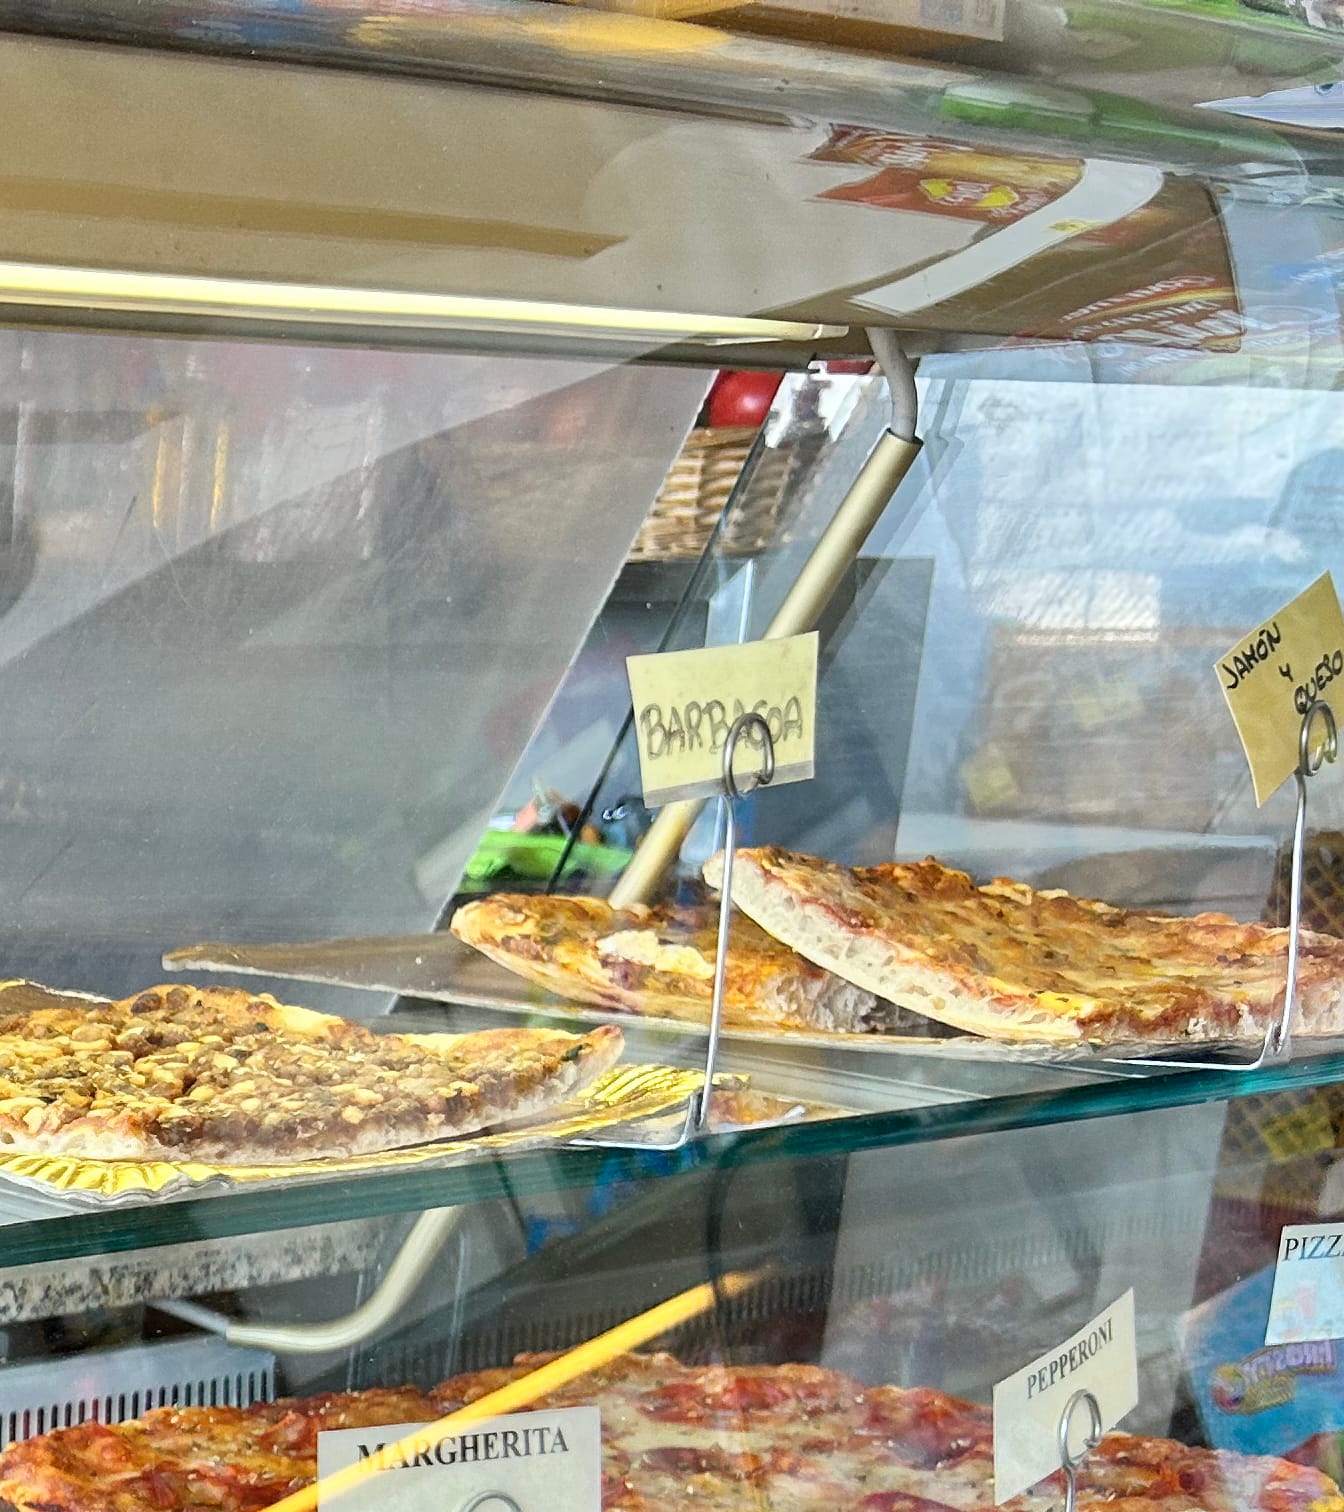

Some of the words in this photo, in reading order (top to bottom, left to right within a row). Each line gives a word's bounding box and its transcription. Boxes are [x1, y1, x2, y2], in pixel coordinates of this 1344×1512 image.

[1282, 1233, 1344, 1261] PIZZ
[1026, 1317, 1114, 1400] PEPPERONI
[356, 1425, 570, 1472] MARGHERITA
